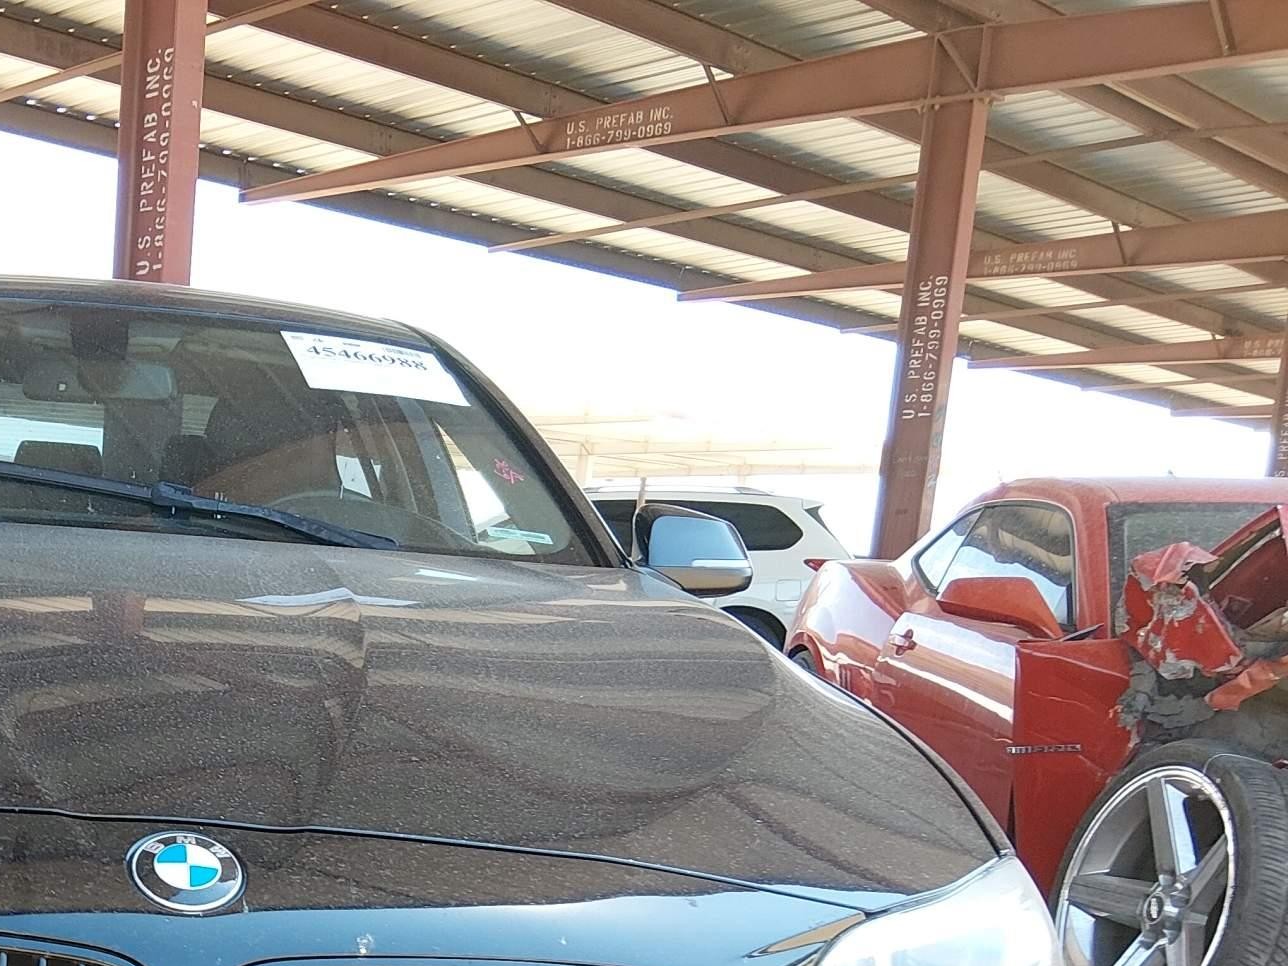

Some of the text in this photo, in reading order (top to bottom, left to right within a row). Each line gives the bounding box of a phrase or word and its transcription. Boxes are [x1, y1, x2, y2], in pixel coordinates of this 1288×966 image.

[567, 106, 673, 135] U.S. PREFAB INC.
[566, 122, 671, 149] 1-866-799-0969
[136, 48, 162, 276] U.S. PREFAB INC.
[306, 345, 428, 371] 45466988
[902, 275, 933, 420] U.S. PREFAB INC.
[918, 276, 948, 418] 1-866-799-0969
[143, 835, 231, 858] BMW
